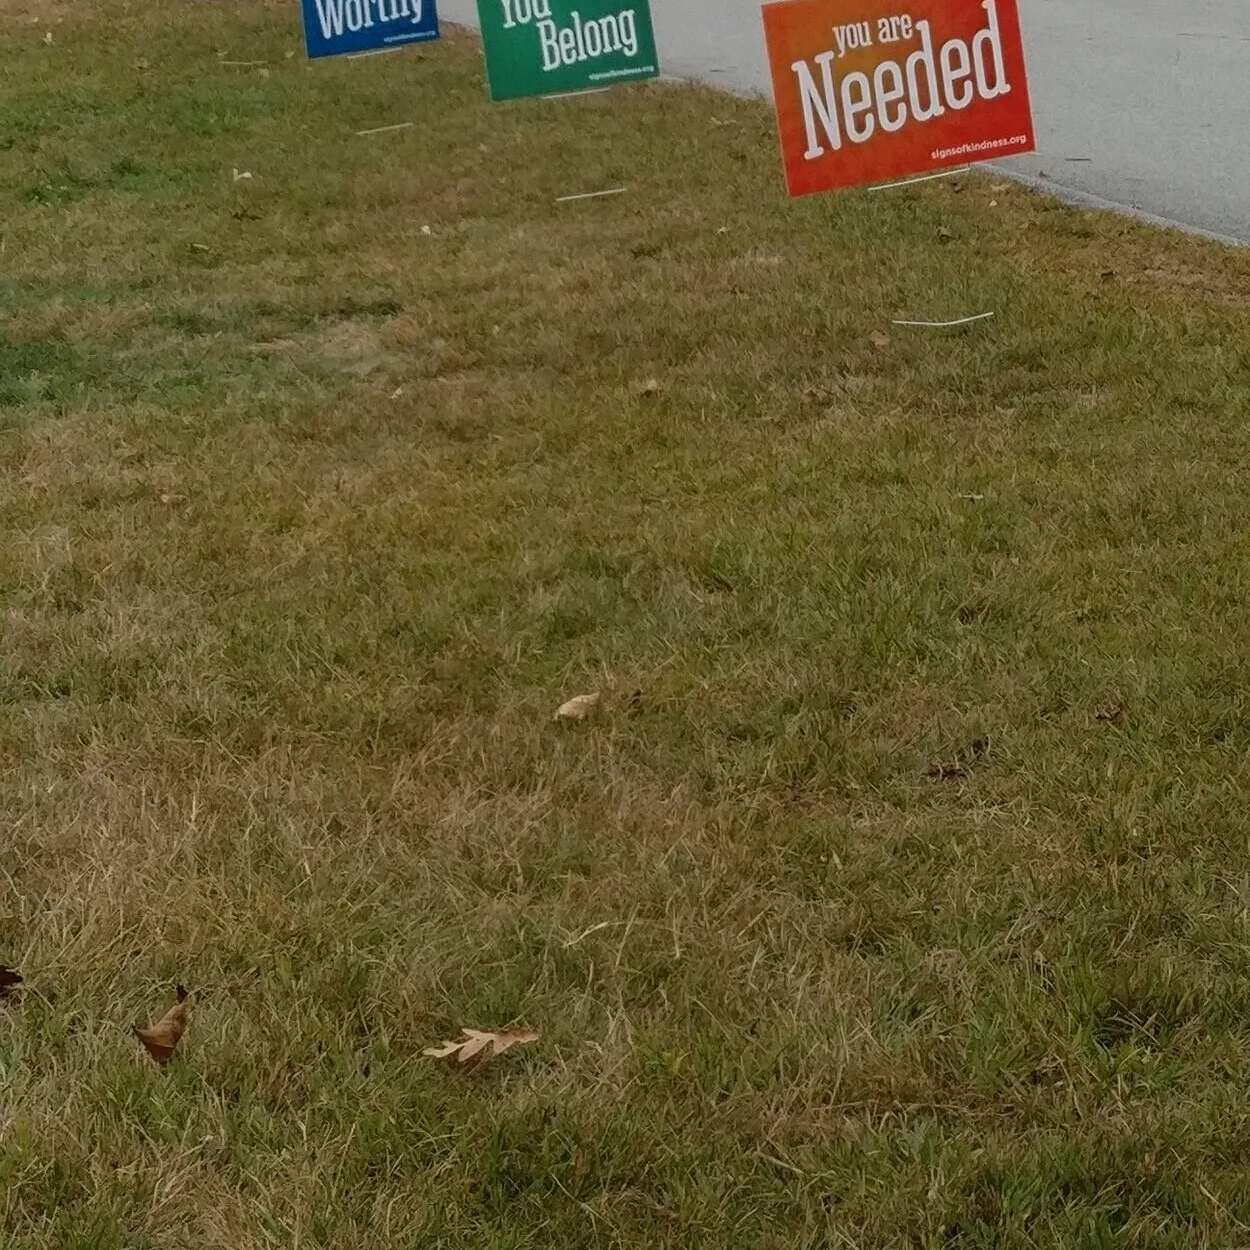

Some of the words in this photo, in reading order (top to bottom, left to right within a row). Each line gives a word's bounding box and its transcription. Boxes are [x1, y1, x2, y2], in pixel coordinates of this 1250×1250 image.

[536, 9, 639, 71] Belong
[832, 20, 873, 58] you
[878, 14, 913, 44] are
[931, 133, 1027, 160] signsofkindness.org
